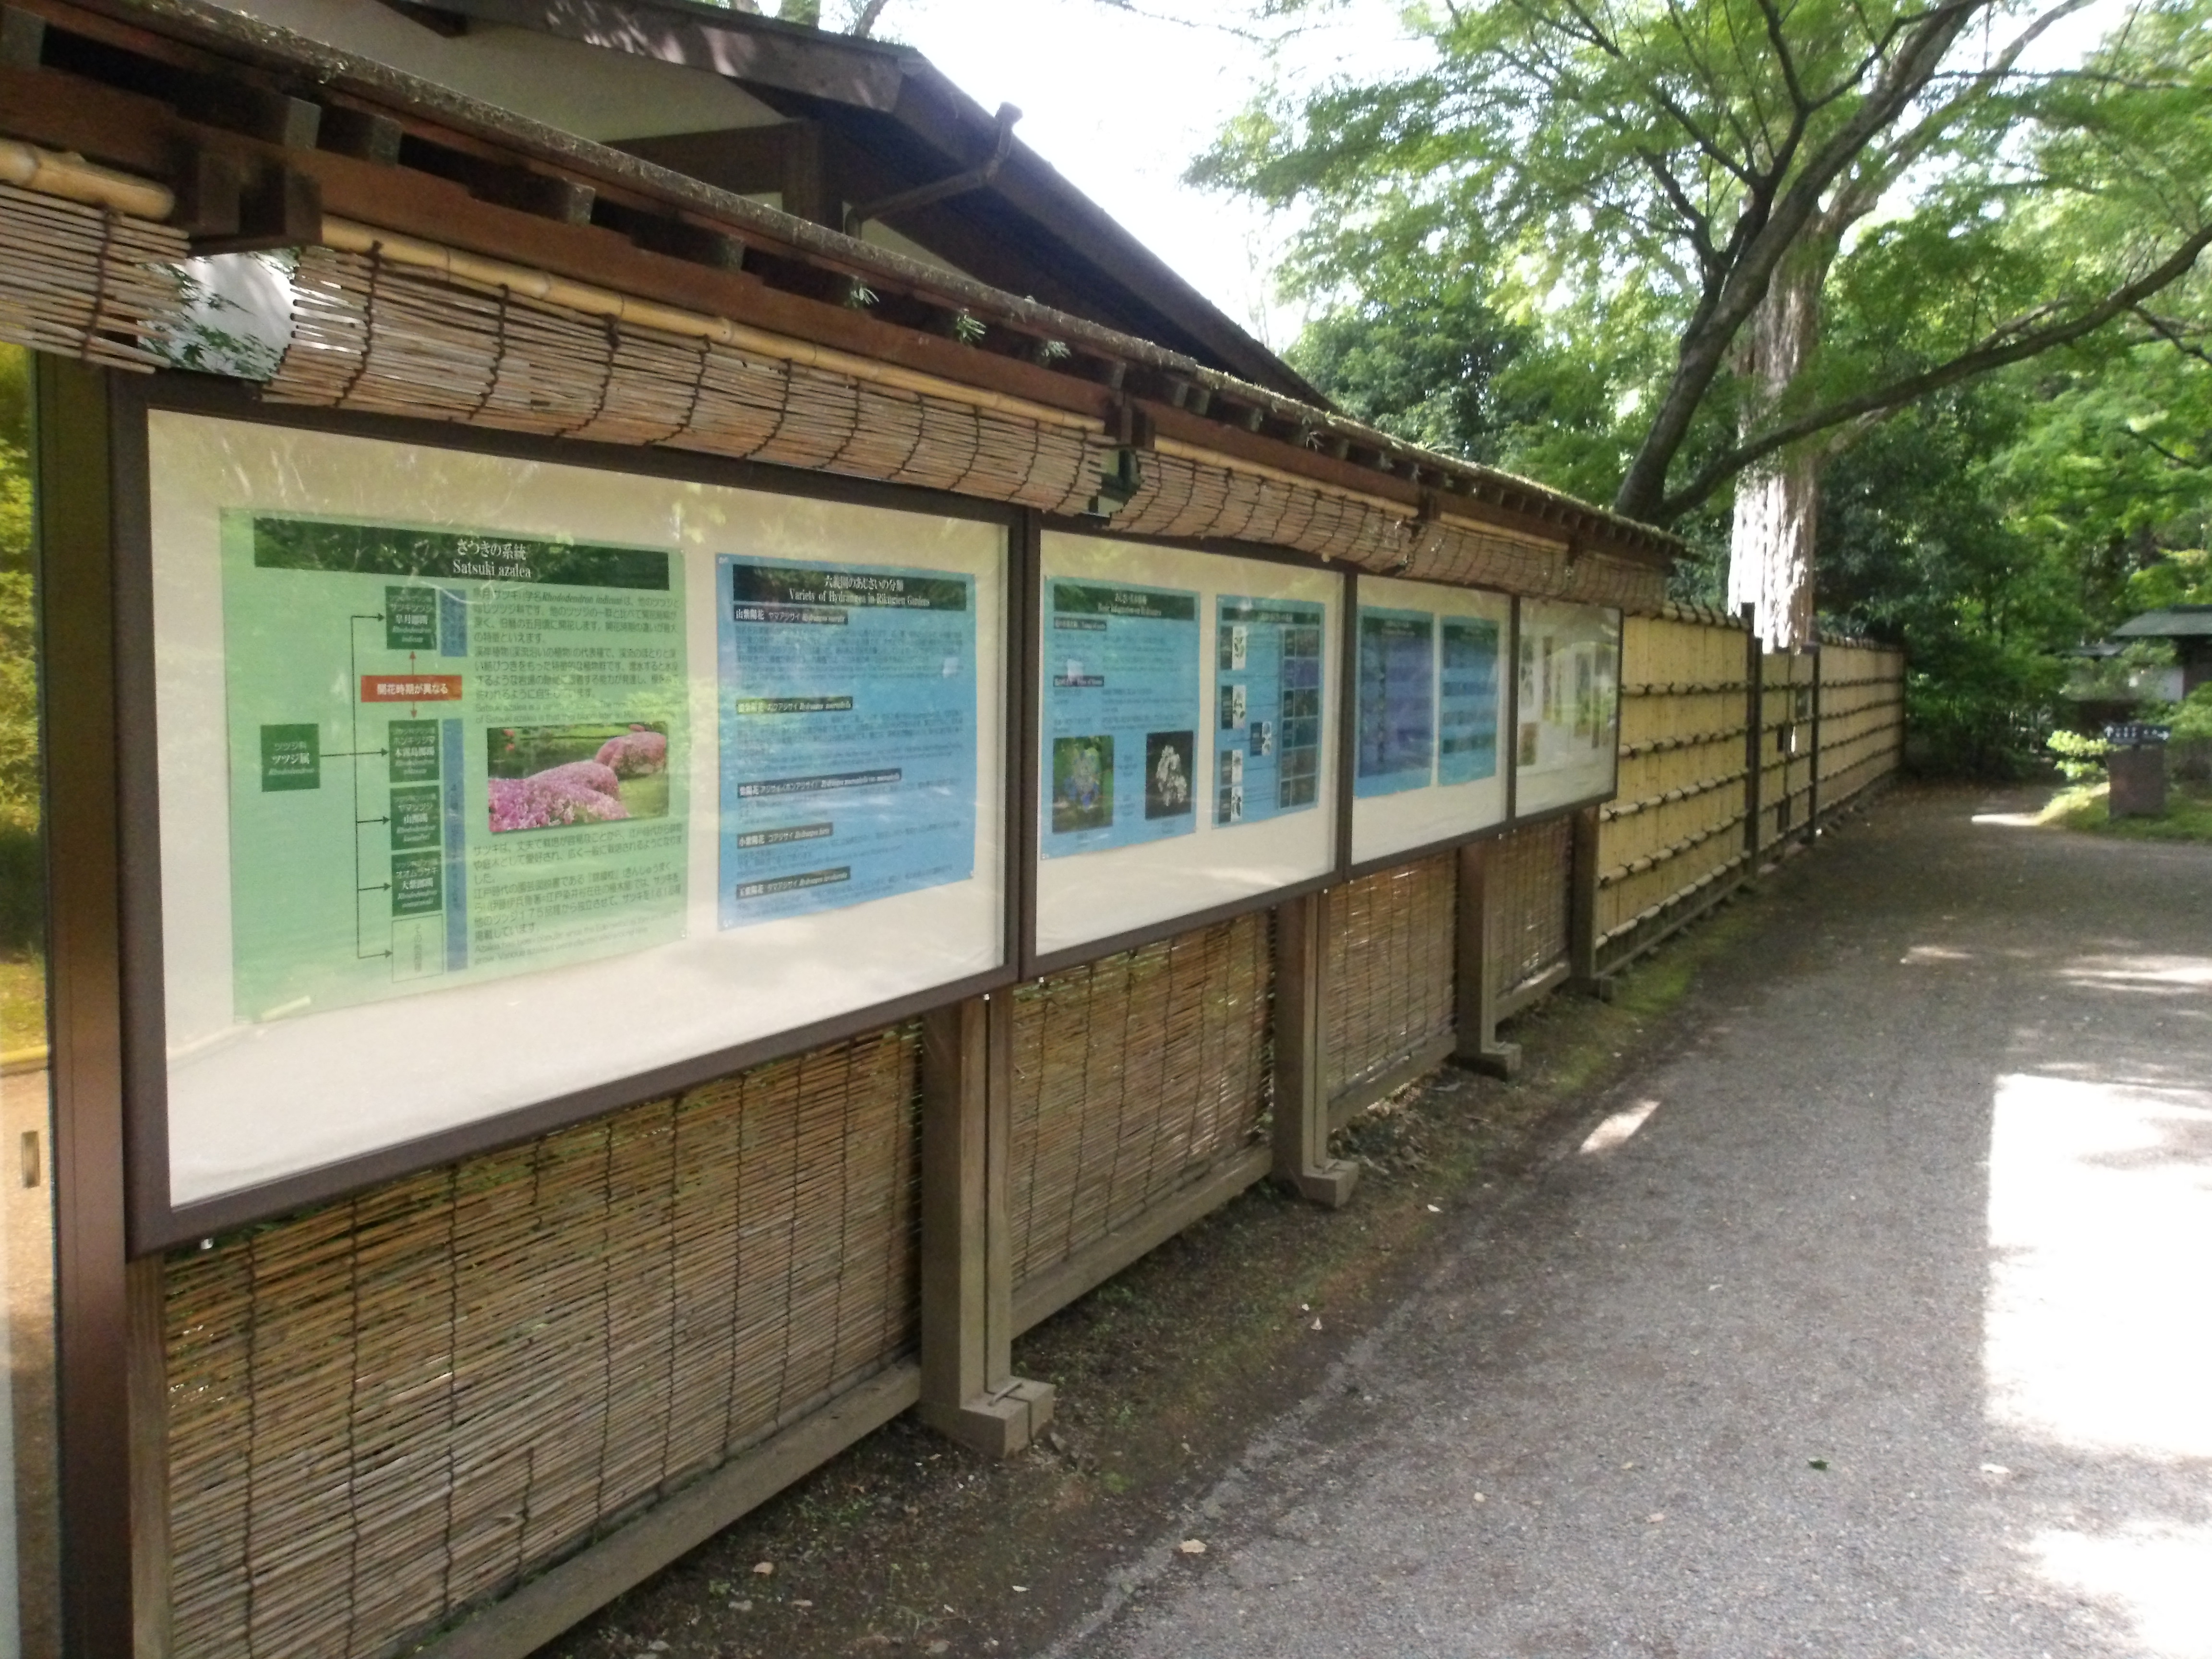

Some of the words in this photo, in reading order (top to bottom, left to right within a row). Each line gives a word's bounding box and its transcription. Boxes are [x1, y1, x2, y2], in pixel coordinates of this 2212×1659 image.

[457, 538, 527, 561] さつきの系統
[453, 559, 495, 577] Satsuki
[498, 564, 531, 578] azalea
[789, 588, 816, 602] Variety
[818, 590, 827, 601] of
[868, 592, 875, 603] in
[377, 684, 448, 696] 開花時期が異なる
